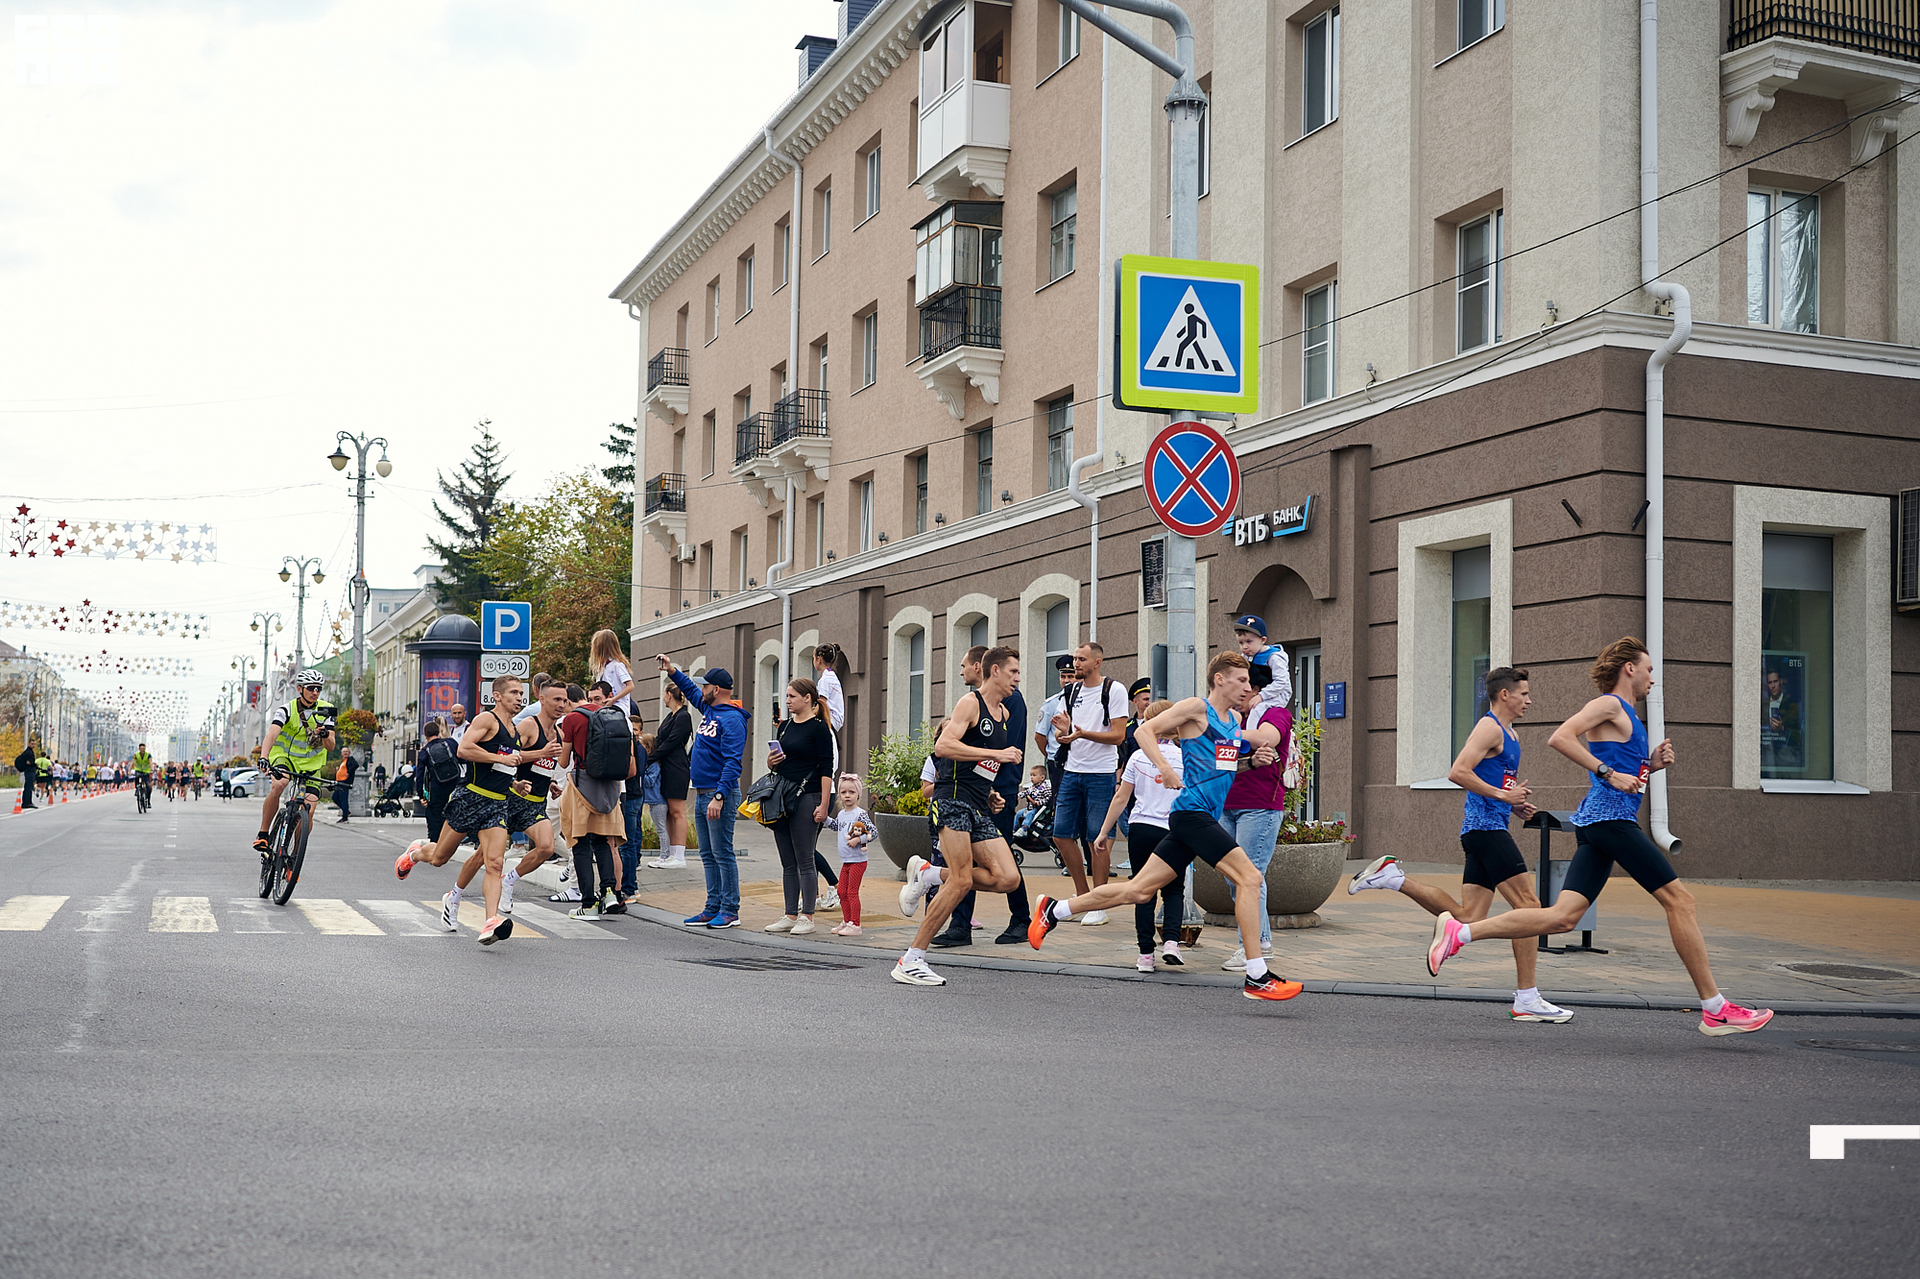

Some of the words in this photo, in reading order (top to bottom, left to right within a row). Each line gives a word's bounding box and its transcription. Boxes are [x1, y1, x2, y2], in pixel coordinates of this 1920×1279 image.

[1234, 515, 1268, 547] ВТБ
[1273, 505, 1303, 525] БАНК
[494, 608, 521, 645] P
[511, 662, 523, 671] 20
[1789, 659, 1802, 667] ВТБ
[425, 671, 460, 679] ВЫБОРЫ
[427, 685, 455, 711] 19
[1218, 748, 1238, 759] 2327
[535, 757, 555, 769] 2000
